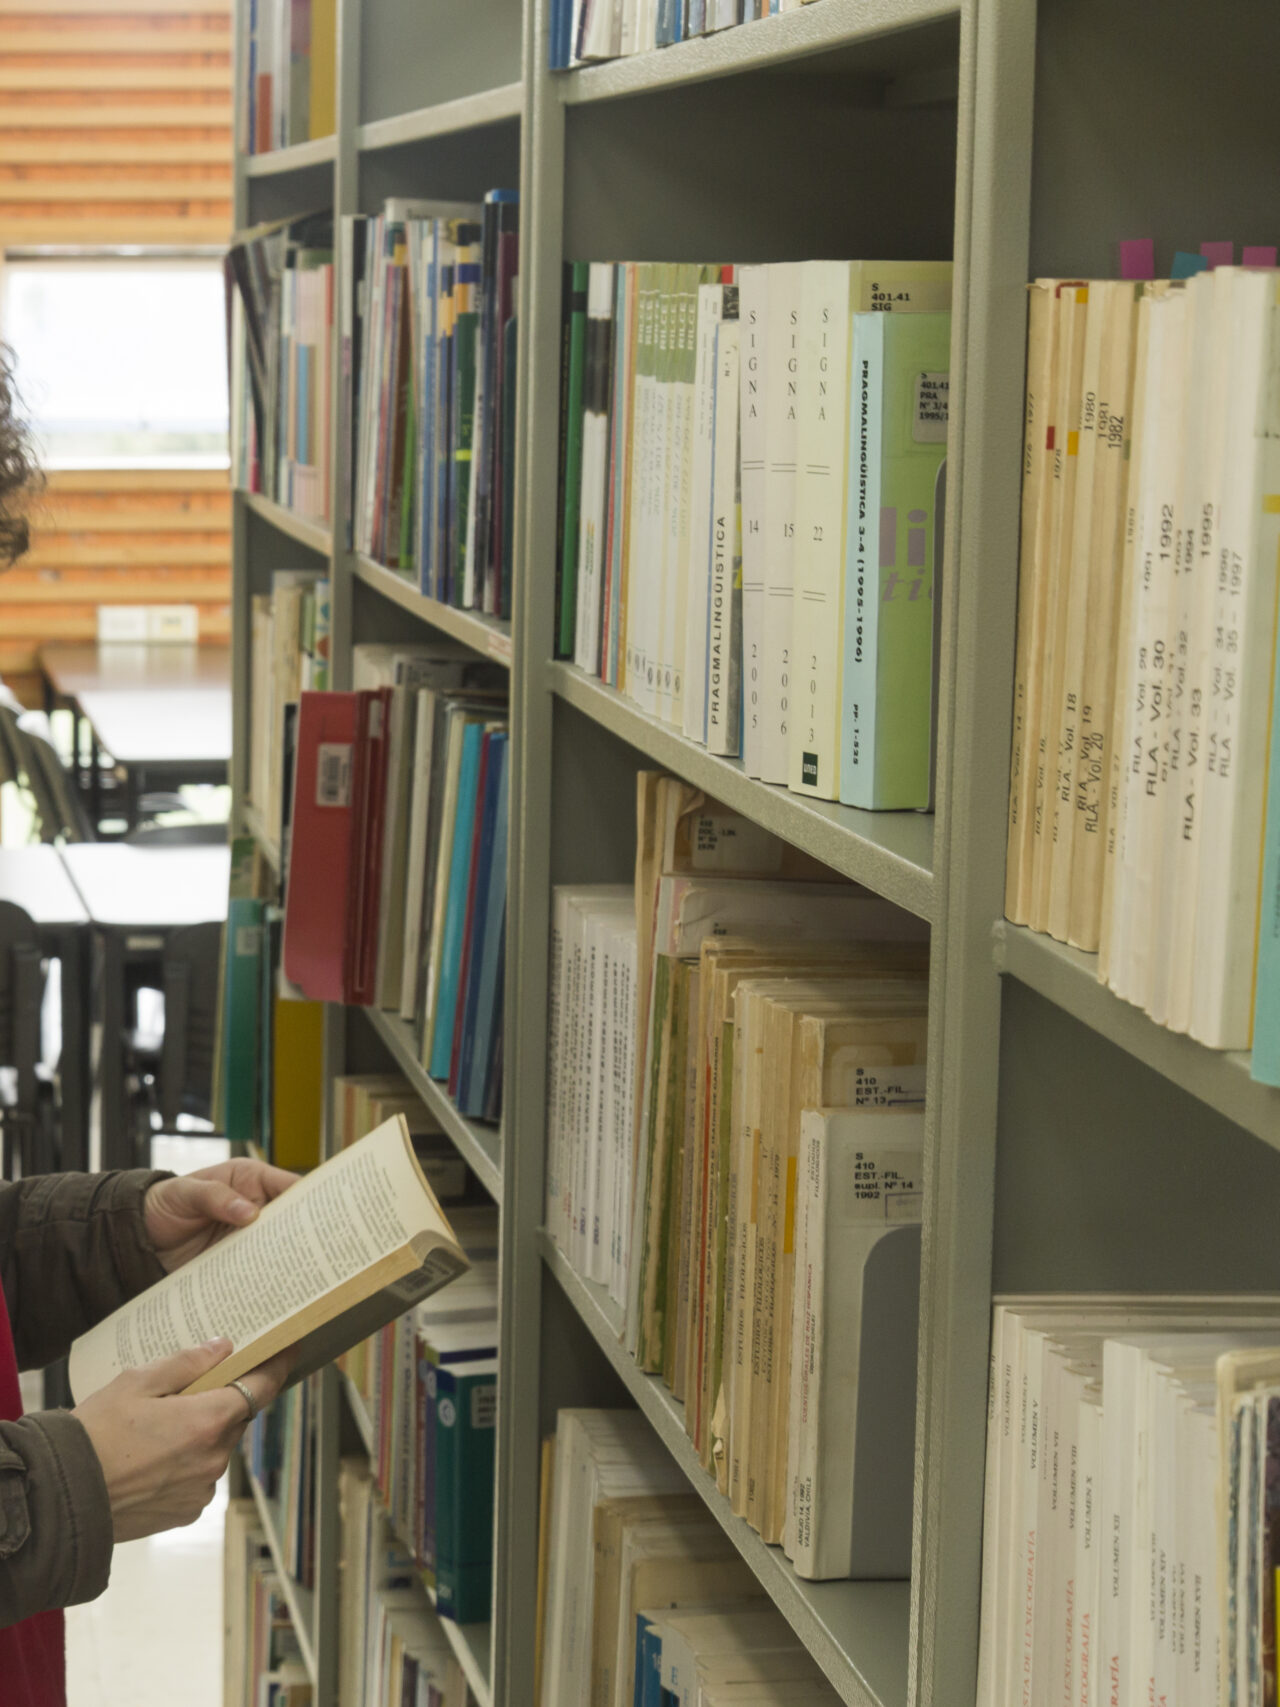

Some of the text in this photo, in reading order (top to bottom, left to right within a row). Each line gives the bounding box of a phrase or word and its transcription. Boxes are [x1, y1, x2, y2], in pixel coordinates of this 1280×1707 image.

[871, 283, 879, 291] S
[871, 293, 911, 301] 401.41
[678, 302, 686, 349] RILCE
[871, 303, 892, 311] SIG
[659, 304, 668, 350] RILCE
[687, 303, 695, 350] RILCE
[748, 310, 758, 418] SIGNA
[787, 310, 798, 420] SIGNA
[818, 308, 829, 420] SIGNA
[1083, 391, 1096, 431] 1980
[1097, 402, 1109, 439] 1981
[1107, 415, 1124, 449] 1982
[749, 519, 759, 534] 14
[783, 522, 794, 538] 15
[813, 526, 824, 542] 22
[857, 526, 866, 553] 3-4
[854, 559, 865, 663] (1995-1996)
[1145, 503, 1174, 797] RLA Vol. 30 1992
[1170, 528, 1195, 770] RLA Vol. 32 1994
[1219, 551, 1243, 778] RLA Vol. 35 1997
[1182, 502, 1214, 841] RLA Vol. 33 1995
[780, 649, 789, 736] 2006
[809, 655, 817, 743] 2013
[1066, 692, 1077, 713] 18
[1082, 705, 1093, 724] 19
[852, 728, 860, 765] 1-525
[1064, 724, 1075, 752] Vol.
[1090, 732, 1104, 751] 20
[1132, 735, 1143, 774] RLA
[1208, 731, 1218, 772] RLA
[1087, 756, 1102, 783] Vol.
[855, 1078, 877, 1086] 410
[856, 1068, 864, 1076] S
[854, 1162, 875, 1170] 410
[855, 1152, 864, 1160] S
[854, 1182, 880, 1190] supl.
[901, 1181, 913, 1189] 14
[855, 1191, 880, 1199] 1992
[1030, 1412, 1038, 1470] VOLUMEN
[1051, 1450, 1059, 1511] VOLUMEN
[1068, 1469, 1076, 1530] VOLUMEN
[1084, 1489, 1092, 1550] VOLUMEN
[1112, 1535, 1120, 1598] VOLUMEN
